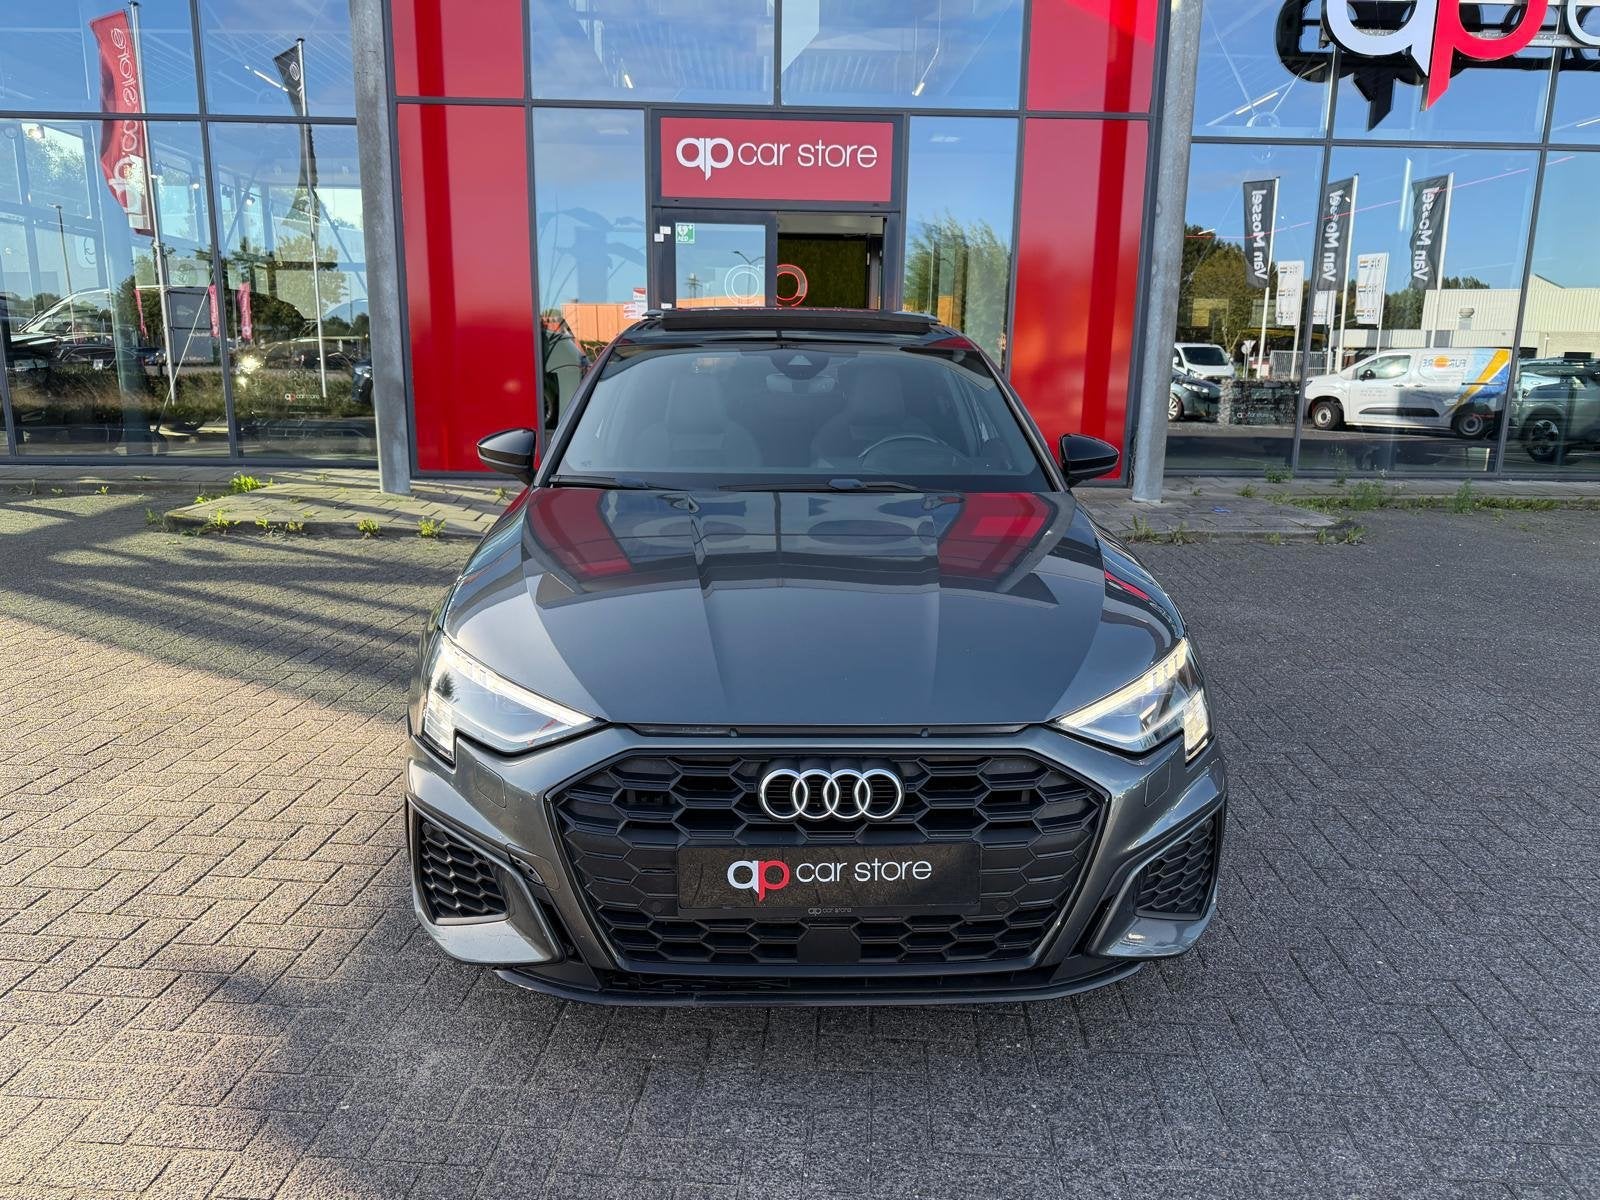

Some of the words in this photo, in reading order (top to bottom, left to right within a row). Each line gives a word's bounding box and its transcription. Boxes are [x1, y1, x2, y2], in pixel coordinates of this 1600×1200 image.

[675, 137, 734, 181] ap
[737, 142, 791, 166] car
[797, 139, 878, 168] store
[727, 860, 791, 902] ap
[796, 862, 848, 882] car
[854, 858, 933, 882] store
